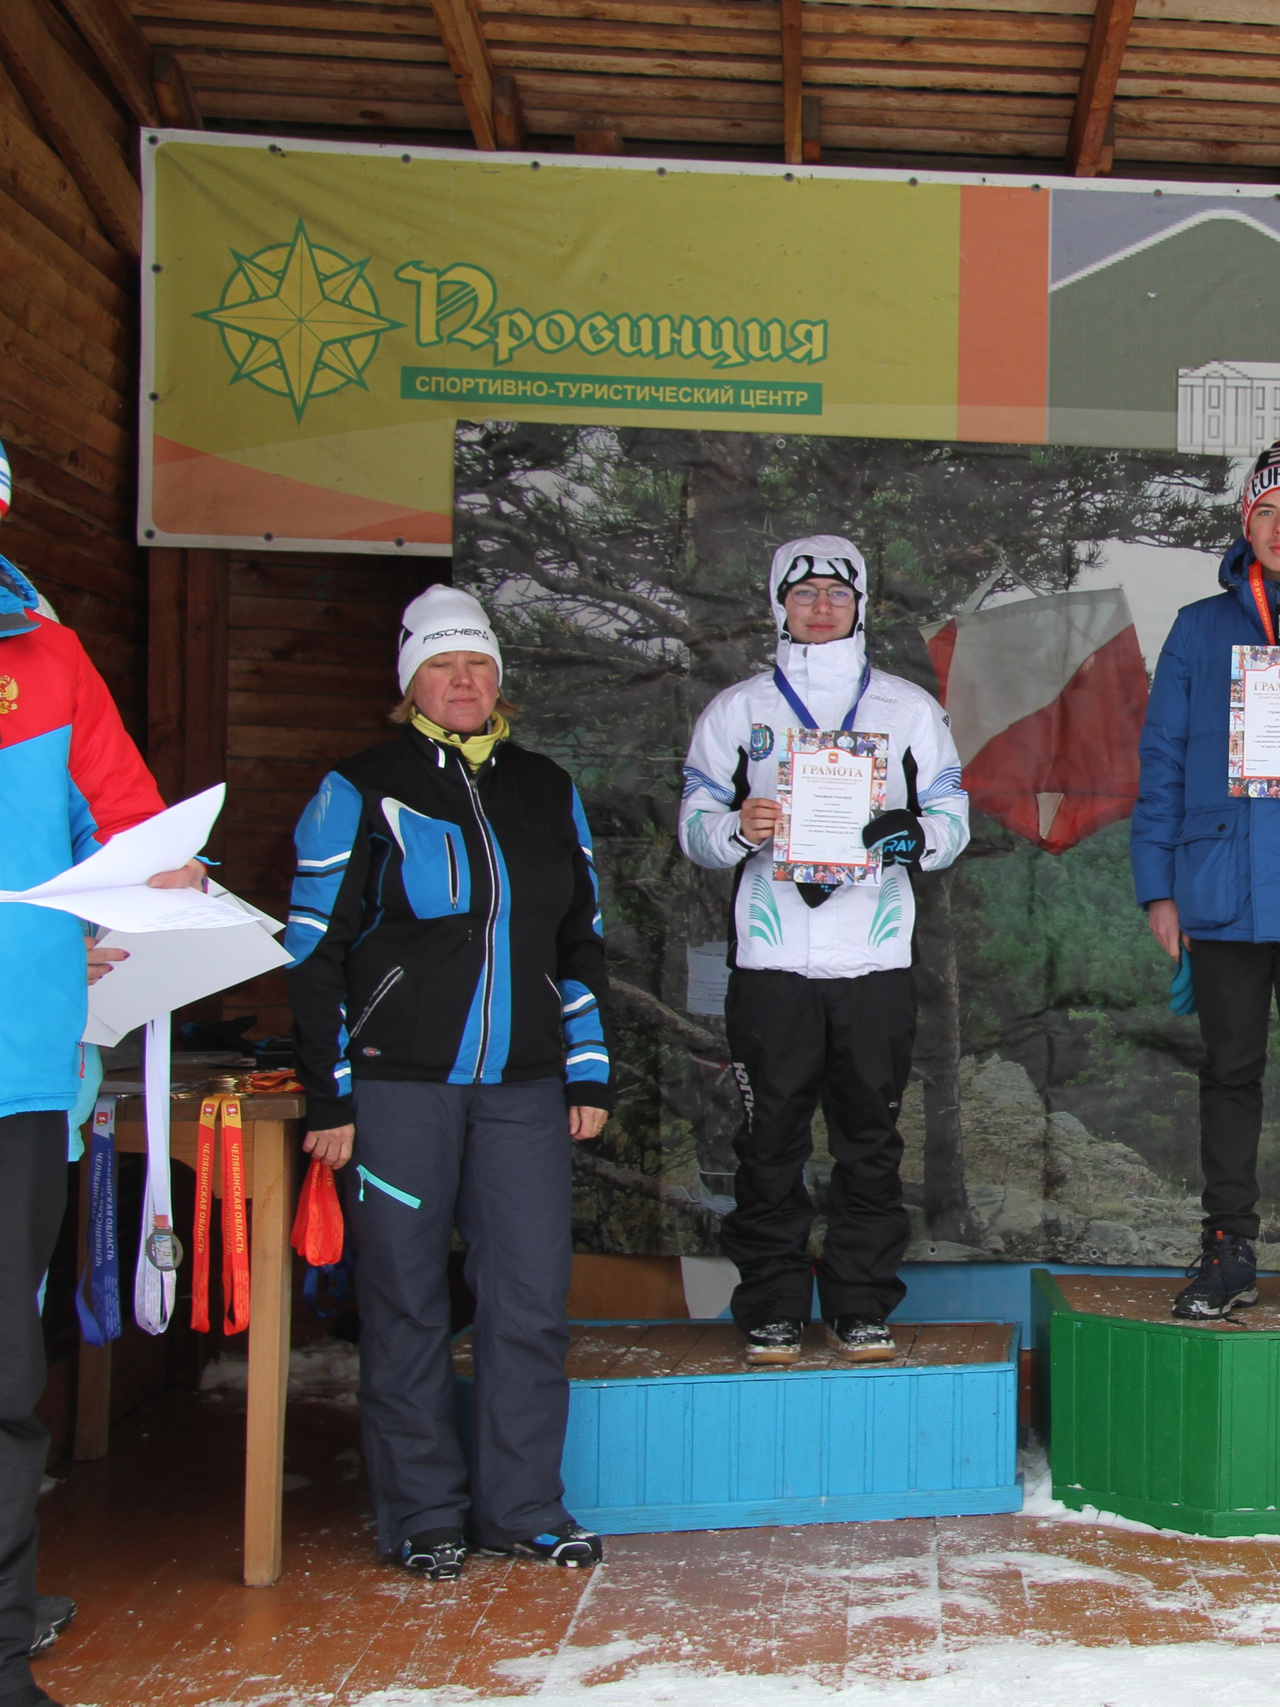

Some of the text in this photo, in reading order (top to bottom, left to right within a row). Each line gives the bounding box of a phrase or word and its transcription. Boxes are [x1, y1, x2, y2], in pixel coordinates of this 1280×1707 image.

[394, 260, 828, 369] Провинция
[414, 375, 809, 408] СПОРТИВНО-ТУРИСТИЧЕСКИЙ ЦЕНТР
[423, 628, 482, 644] FISCHER
[802, 764, 864, 778] ГРАМОТА
[200, 1142, 210, 1210] ЧЕЛЯБИНСКАЯ
[231, 1142, 245, 1254] ЧЕЛЯБИНСКАЯ ОБЛАСТЬ
